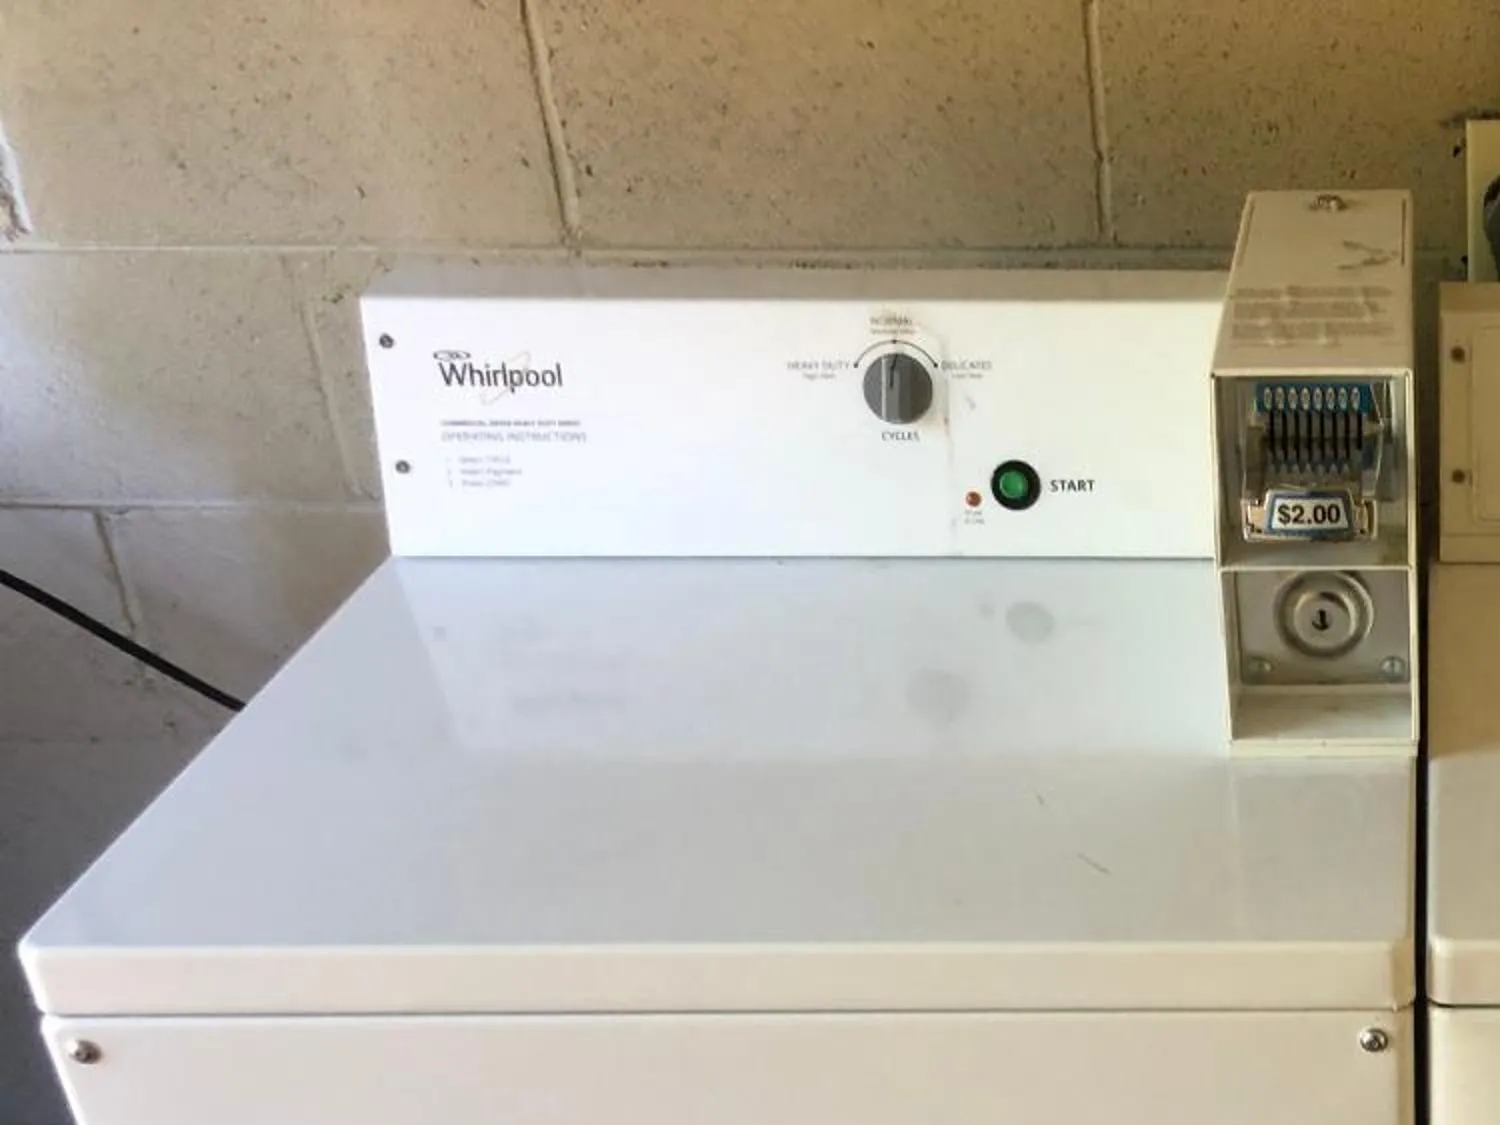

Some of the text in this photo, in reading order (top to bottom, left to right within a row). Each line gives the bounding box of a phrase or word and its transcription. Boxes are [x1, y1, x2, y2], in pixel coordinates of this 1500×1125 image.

[438, 361, 564, 393] Whirlpool
[880, 430, 921, 442] CYCLES
[1049, 479, 1096, 493] START
[1276, 502, 1342, 526] $2.00
